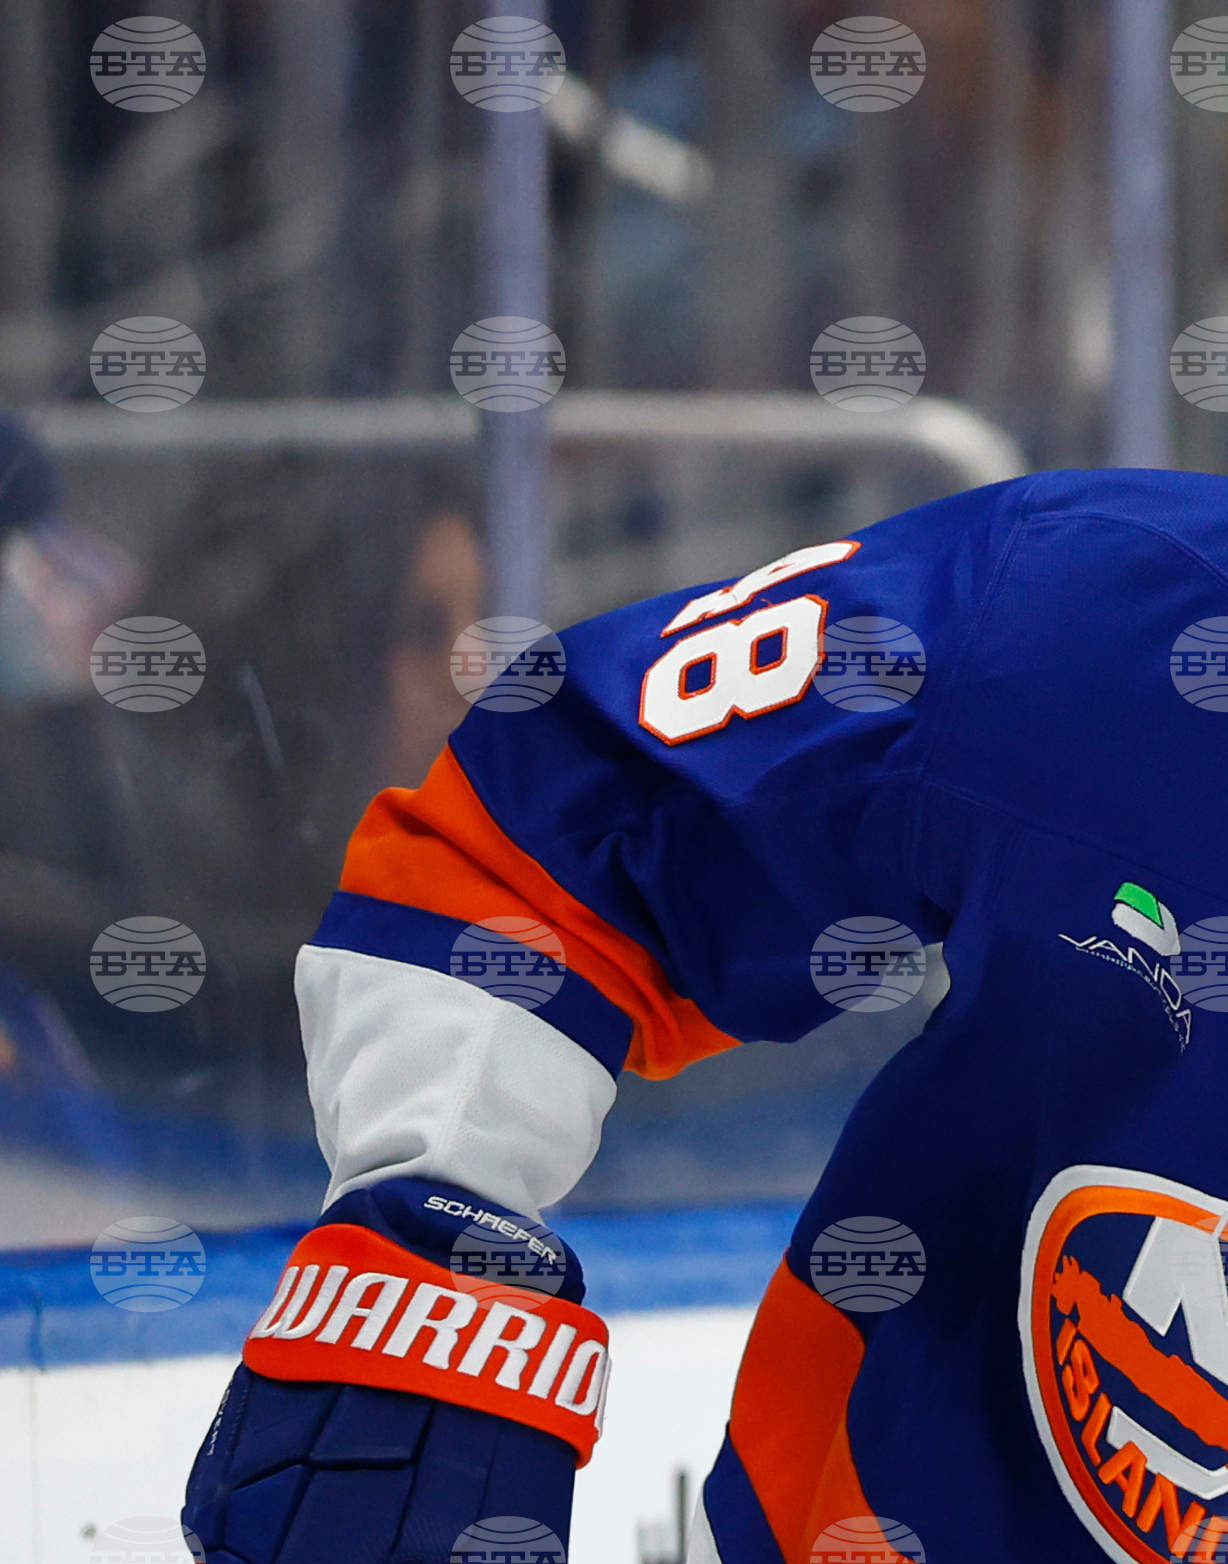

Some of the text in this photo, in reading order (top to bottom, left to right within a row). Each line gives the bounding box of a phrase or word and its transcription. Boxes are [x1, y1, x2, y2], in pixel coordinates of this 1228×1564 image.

[638, 540, 862, 745] 48
[1057, 932, 1192, 1045] VANDA
[423, 1195, 558, 1265] SCHAEFER
[249, 1264, 611, 1437] WARRIO
